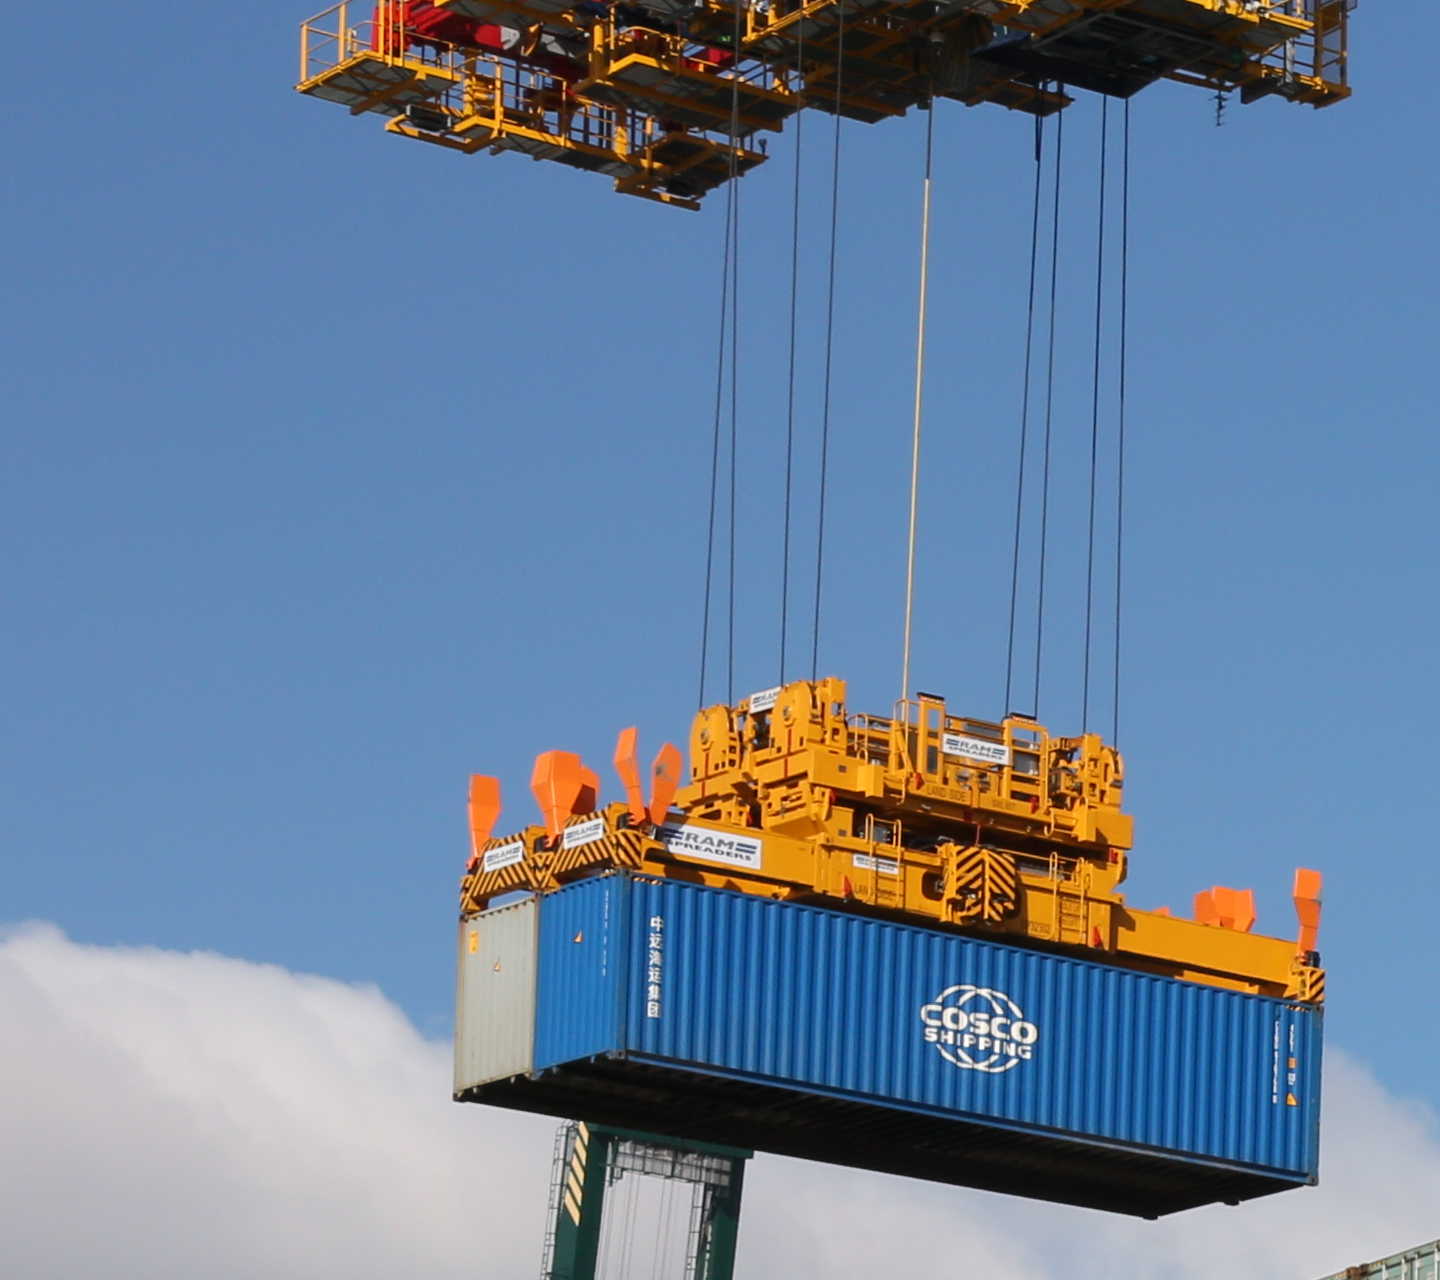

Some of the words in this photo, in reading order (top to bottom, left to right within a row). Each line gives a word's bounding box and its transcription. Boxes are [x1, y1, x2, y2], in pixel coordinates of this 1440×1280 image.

[958, 740, 989, 756] RAM
[685, 831, 736, 851] RAM
[920, 1003, 1038, 1045] COSCO
[924, 1026, 1033, 1061] SHIPPING
